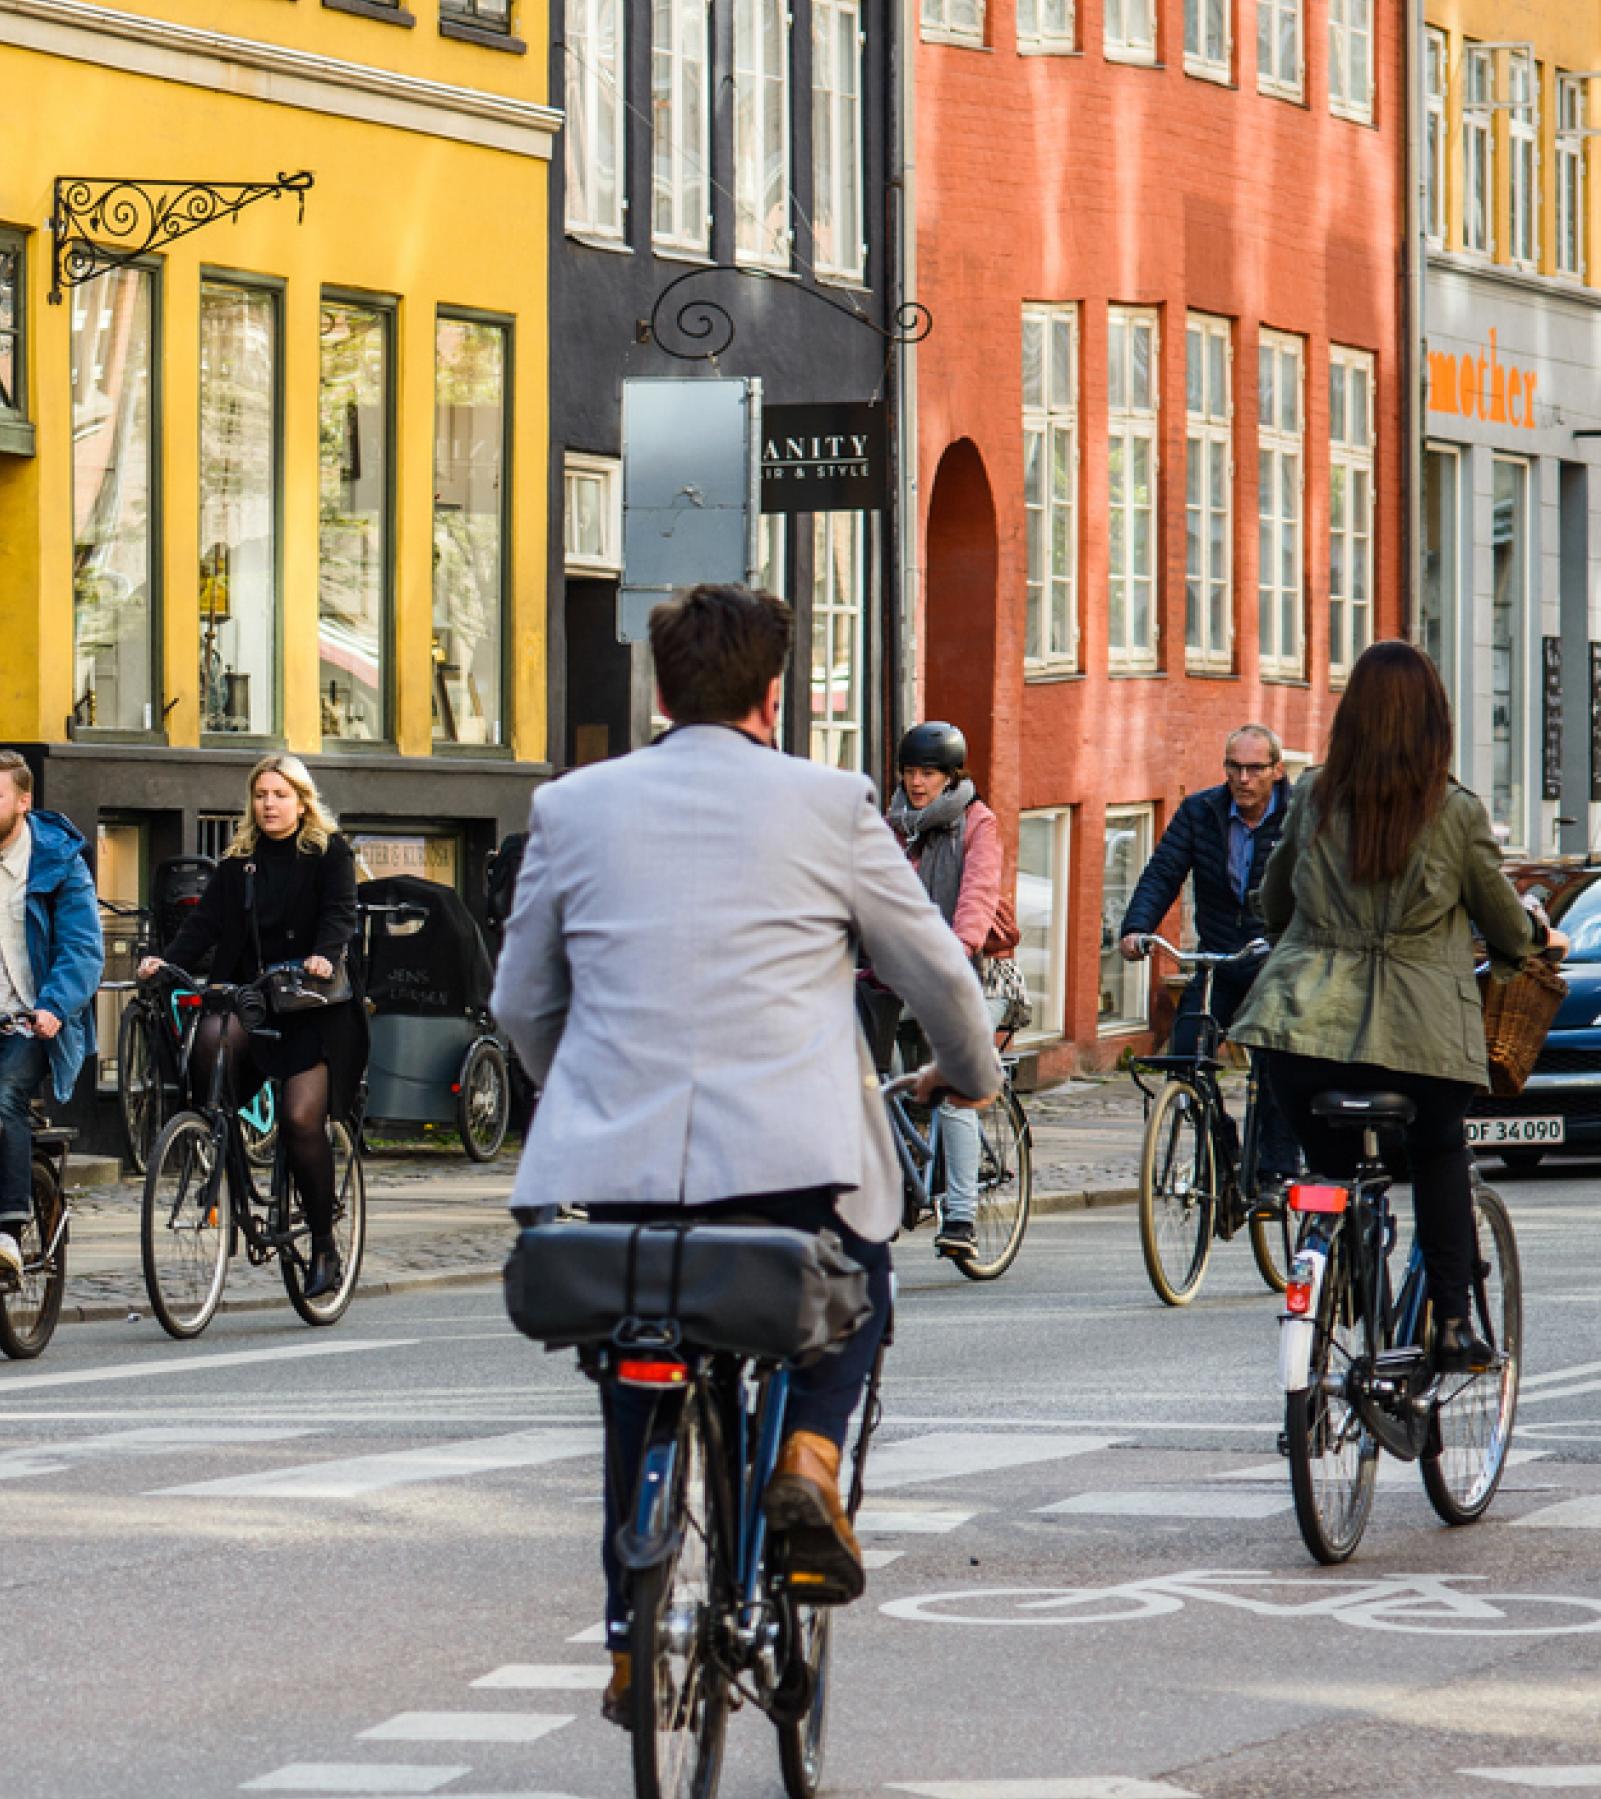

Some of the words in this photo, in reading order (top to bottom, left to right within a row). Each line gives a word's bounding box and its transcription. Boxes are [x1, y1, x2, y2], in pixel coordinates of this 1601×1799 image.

[1426, 326, 1537, 430] mother
[761, 467, 784, 480] IR
[1496, 1121, 1519, 1141] 34
[1523, 1120, 1560, 1141] 090
